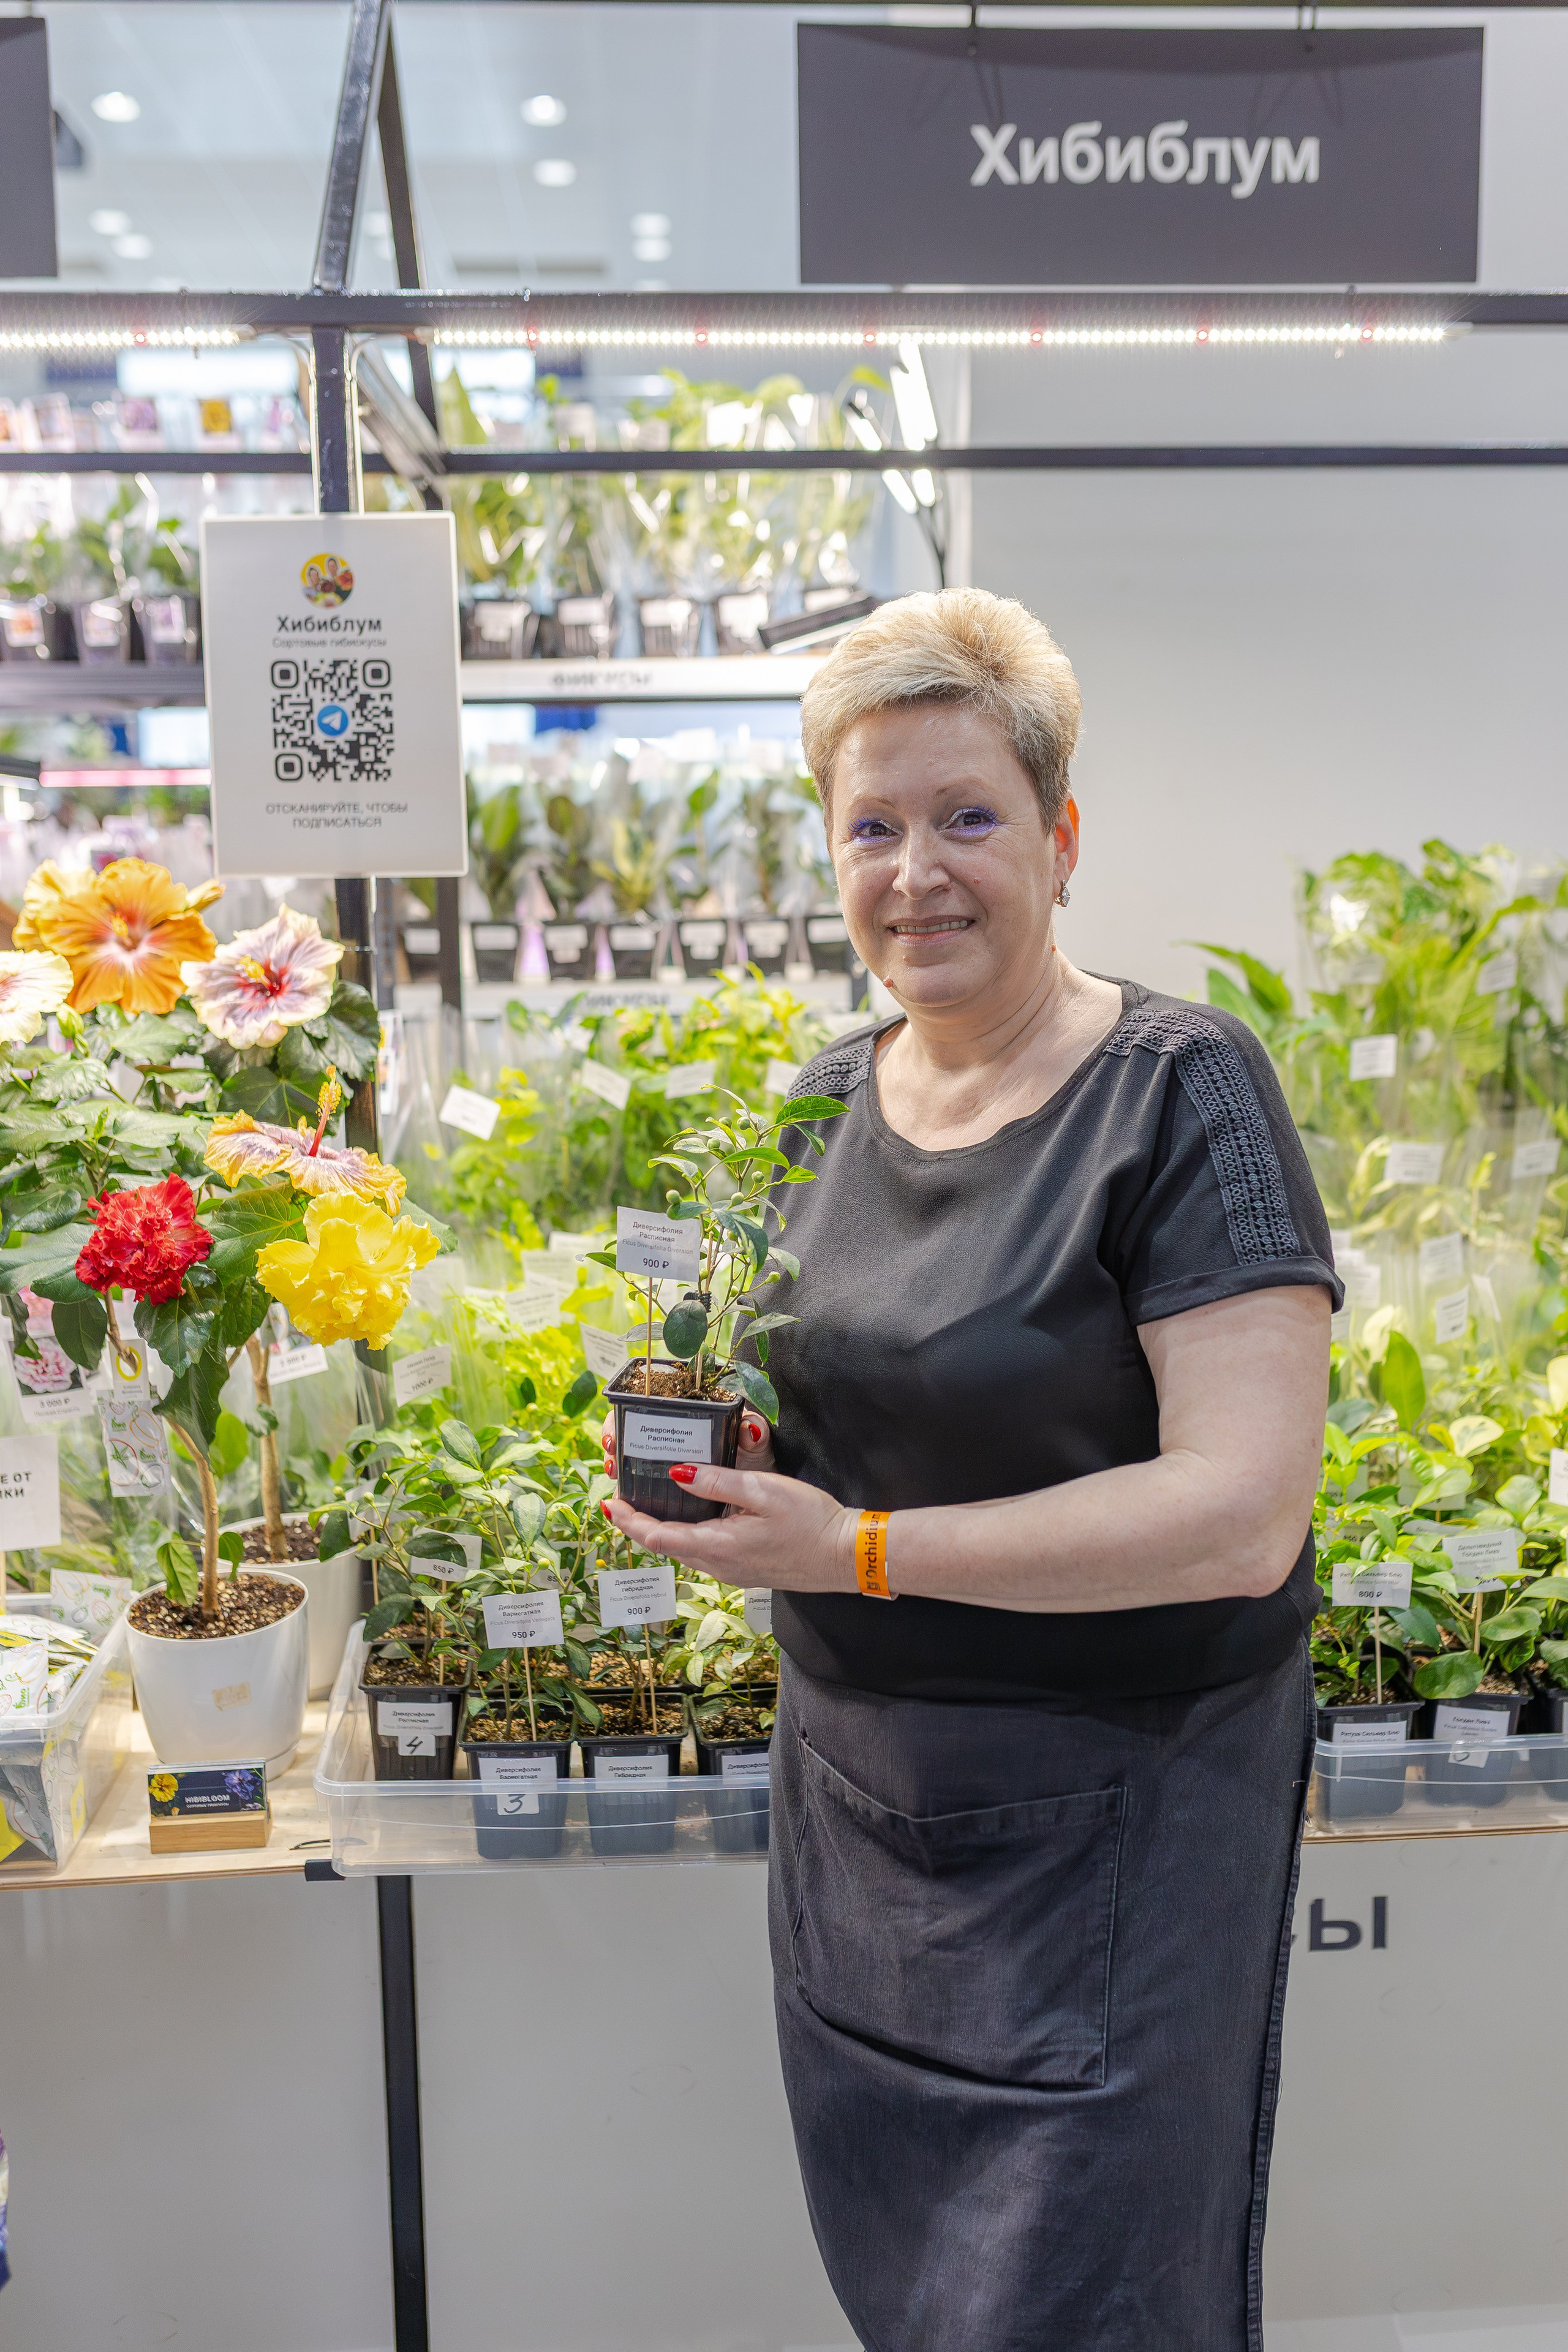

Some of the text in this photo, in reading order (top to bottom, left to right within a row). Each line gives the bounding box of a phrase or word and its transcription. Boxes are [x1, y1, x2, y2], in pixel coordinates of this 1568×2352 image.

[970, 120, 1321, 200] Хибиблум
[277, 615, 382, 636] Хибиблум
[265, 800, 409, 815] ОТСКАНИРУЙТЕ, ЧТОБЫ
[293, 816, 382, 829] ПОДПИСАТЬСЯ
[633, 1221, 683, 1234] Диверсифолия
[639, 1232, 675, 1242] Расписная
[637, 1242, 666, 1251] Diversifolia
[643, 1257, 660, 1268] 900
[640, 1425, 693, 1436] Диверсифолия
[647, 1434, 685, 1444] Расписная
[13, 1471, 32, 1483] ОТ
[615, 1577, 660, 1586] Диверсифолия
[499, 1601, 544, 1611] Диверсифолия
[627, 1607, 643, 1616] 900
[511, 1630, 527, 1639] 950
[405, 1736, 424, 1755] 4
[503, 1793, 527, 1814] 3
[1291, 1895, 1389, 1952] Ы
